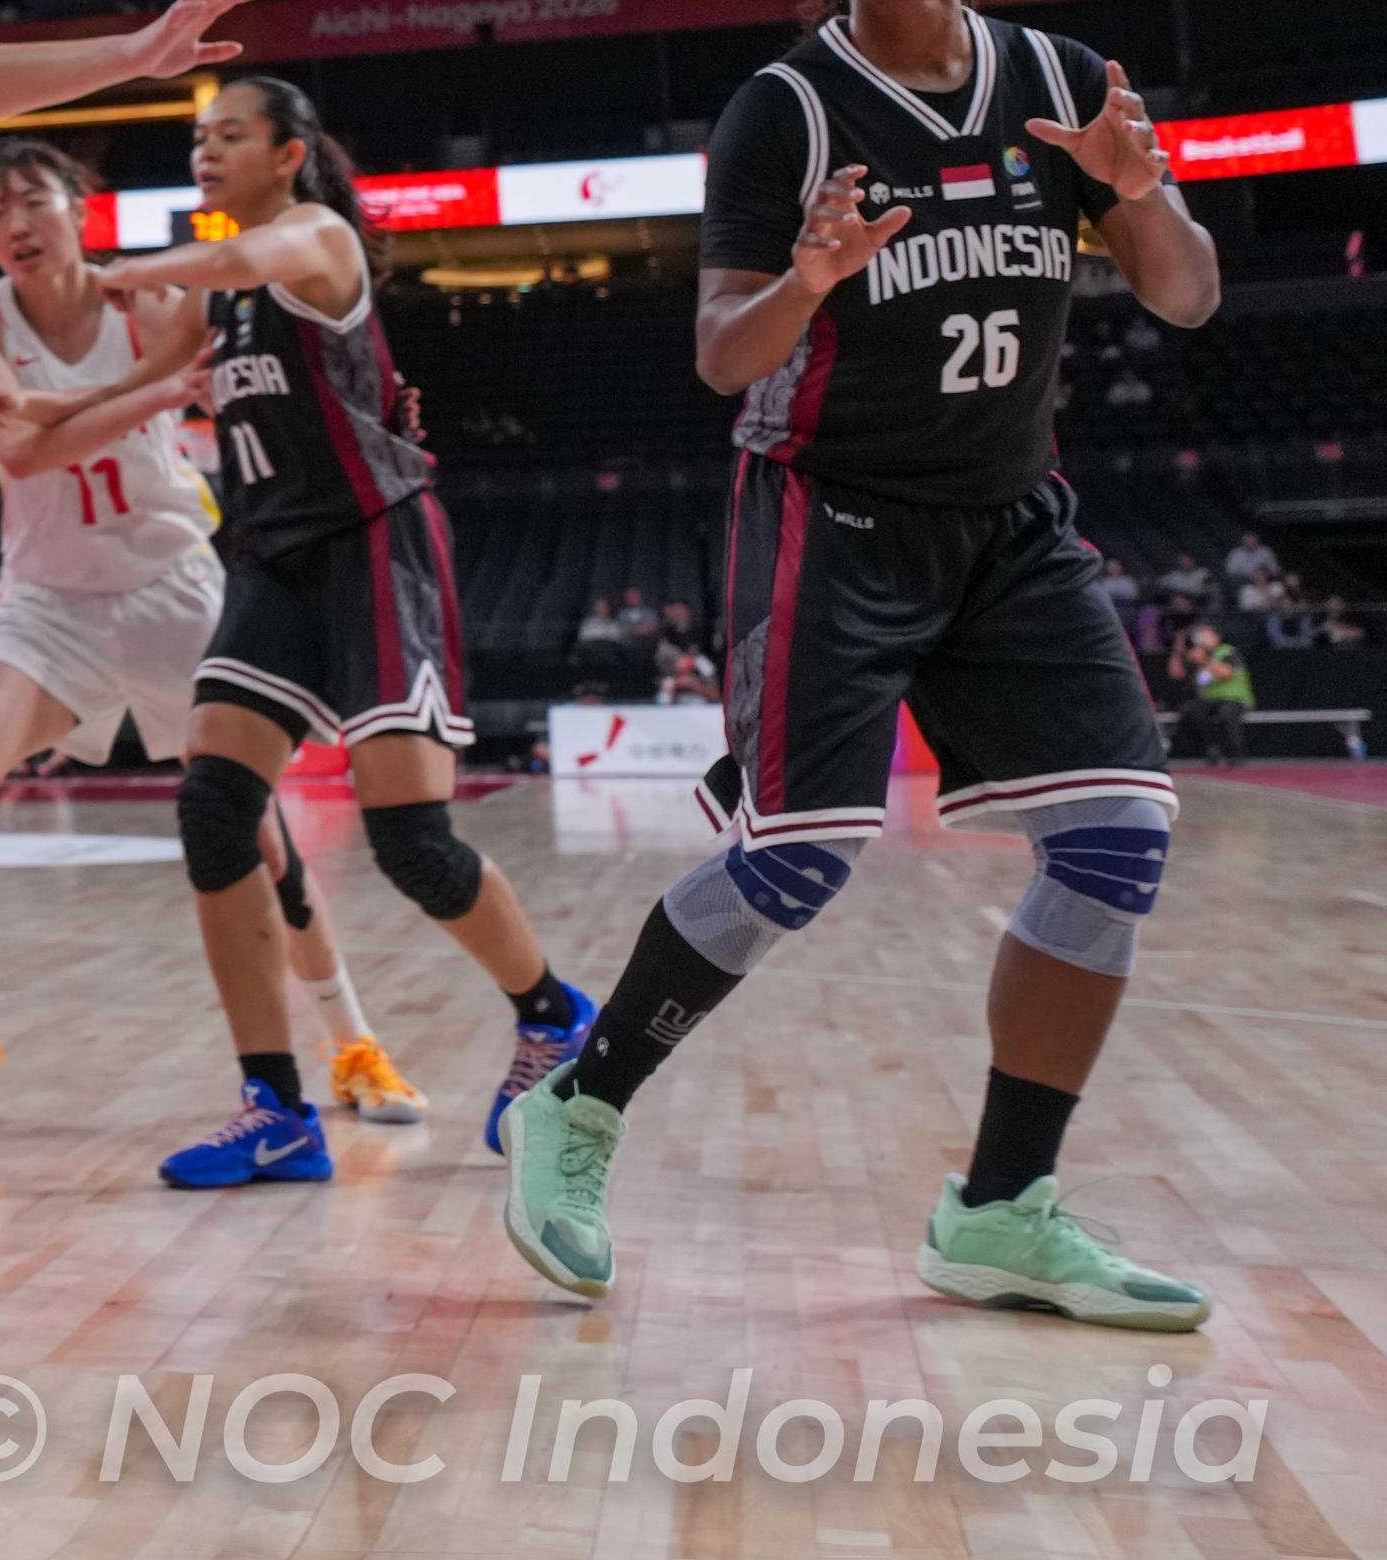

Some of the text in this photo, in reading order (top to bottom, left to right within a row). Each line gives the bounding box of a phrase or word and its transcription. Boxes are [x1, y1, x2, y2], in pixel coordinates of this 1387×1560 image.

[311, 1, 530, 38] Aichi-Nagoya
[867, 223, 1072, 306] INDONESIA
[940, 308, 1021, 394] 26
[230, 422, 276, 485] 11
[67, 456, 130, 525] 11
